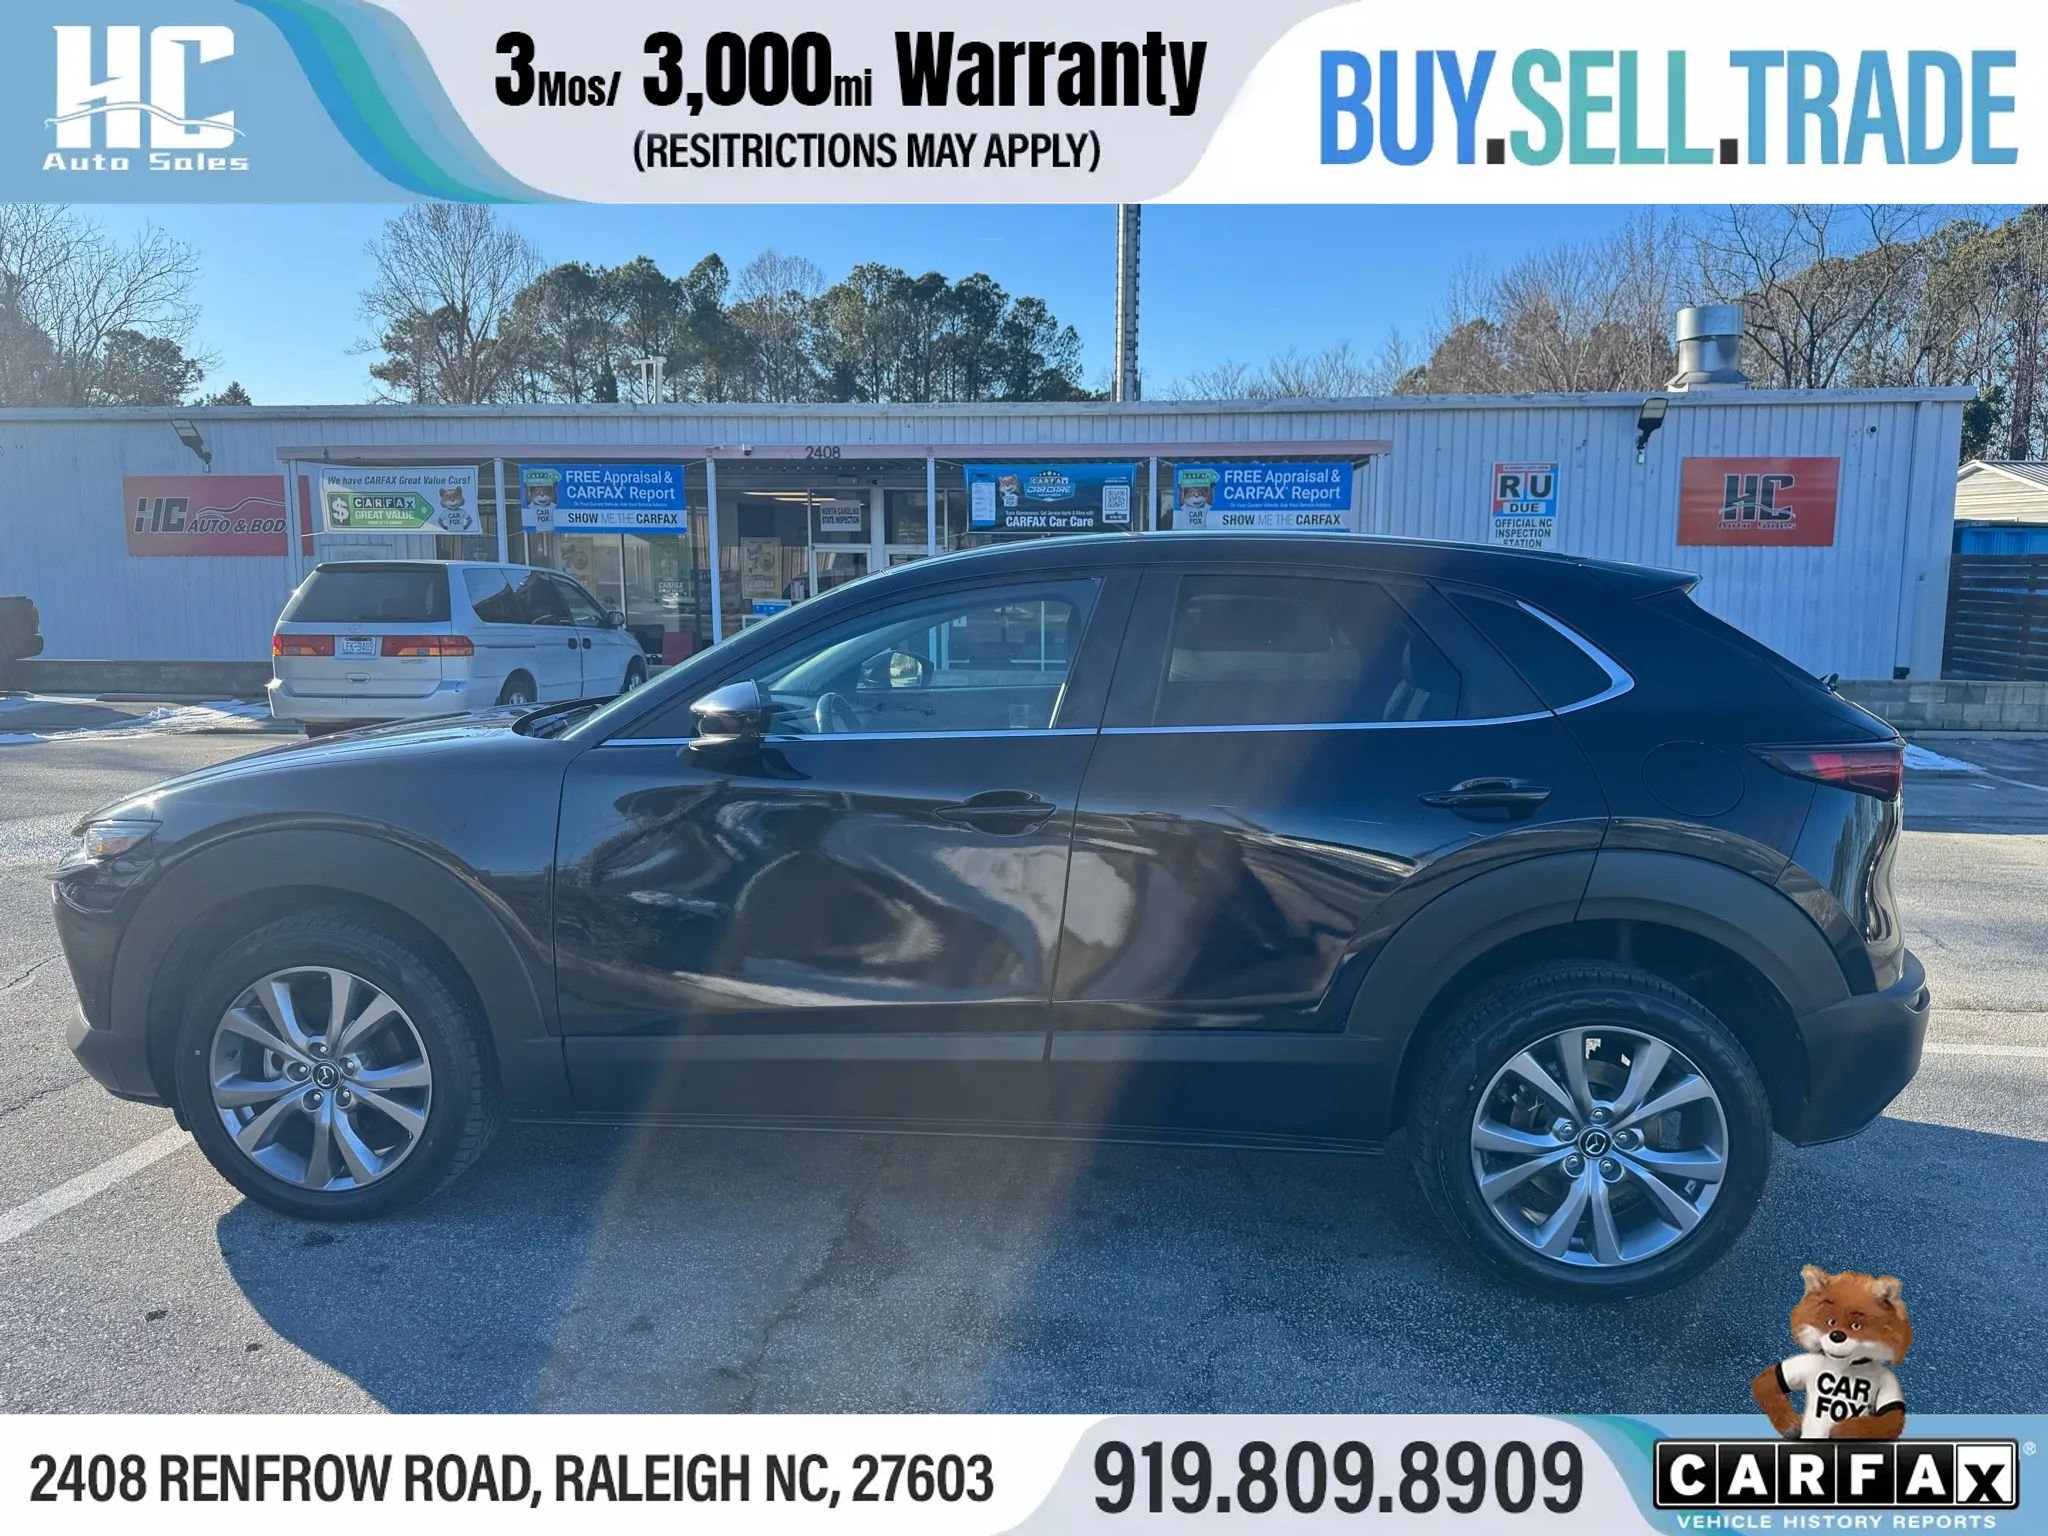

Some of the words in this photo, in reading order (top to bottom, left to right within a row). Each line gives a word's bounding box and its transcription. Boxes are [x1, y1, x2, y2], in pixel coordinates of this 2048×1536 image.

[805, 446, 841, 459] 2408
[328, 476, 341, 485] We
[342, 476, 362, 485] have
[364, 476, 397, 485] CARFAX
[399, 476, 422, 485] Great
[423, 476, 446, 485] Value
[448, 476, 471, 485] Cars!
[565, 470, 601, 484] FREE
[603, 470, 662, 487] Appraisal
[664, 471, 673, 484] &
[1031, 477, 1069, 485] CARFAX
[1224, 470, 1262, 483] FREE
[1264, 469, 1328, 486] Appraisal
[1331, 469, 1341, 483] &
[1499, 475, 1520, 498] R
[1530, 475, 1552, 498] U
[566, 486, 625, 499] CARFAX
[629, 486, 676, 502] Report
[1223, 486, 1286, 500] CARFAX
[1292, 486, 1341, 502] Report
[1722, 474, 1796, 521] HC
[353, 497, 416, 509] CARFAX
[1510, 503, 1539, 512] DUE
[134, 497, 189, 533] HC
[355, 510, 384, 520] GREAT
[385, 510, 415, 520] VALUE
[568, 512, 598, 523] SHOW
[600, 513, 617, 524] ME
[618, 513, 635, 524] THE
[636, 513, 678, 524] CARFAX
[1222, 514, 1255, 525] SHOW
[1258, 514, 1274, 525] ME
[1275, 514, 1294, 525] THE
[1295, 514, 1341, 525] CARFAX
[186, 518, 231, 533] AUTO
[233, 518, 248, 533] &
[250, 518, 288, 533] BOD
[1005, 516, 1046, 527] CARFAX
[1049, 516, 1068, 527] Car
[1070, 516, 1094, 527] Care
[1495, 518, 1537, 527] OFFICIAL
[1539, 518, 1552, 527] NC
[1495, 528, 1551, 538] INSPECTION
[1503, 539, 1542, 547] STATION
